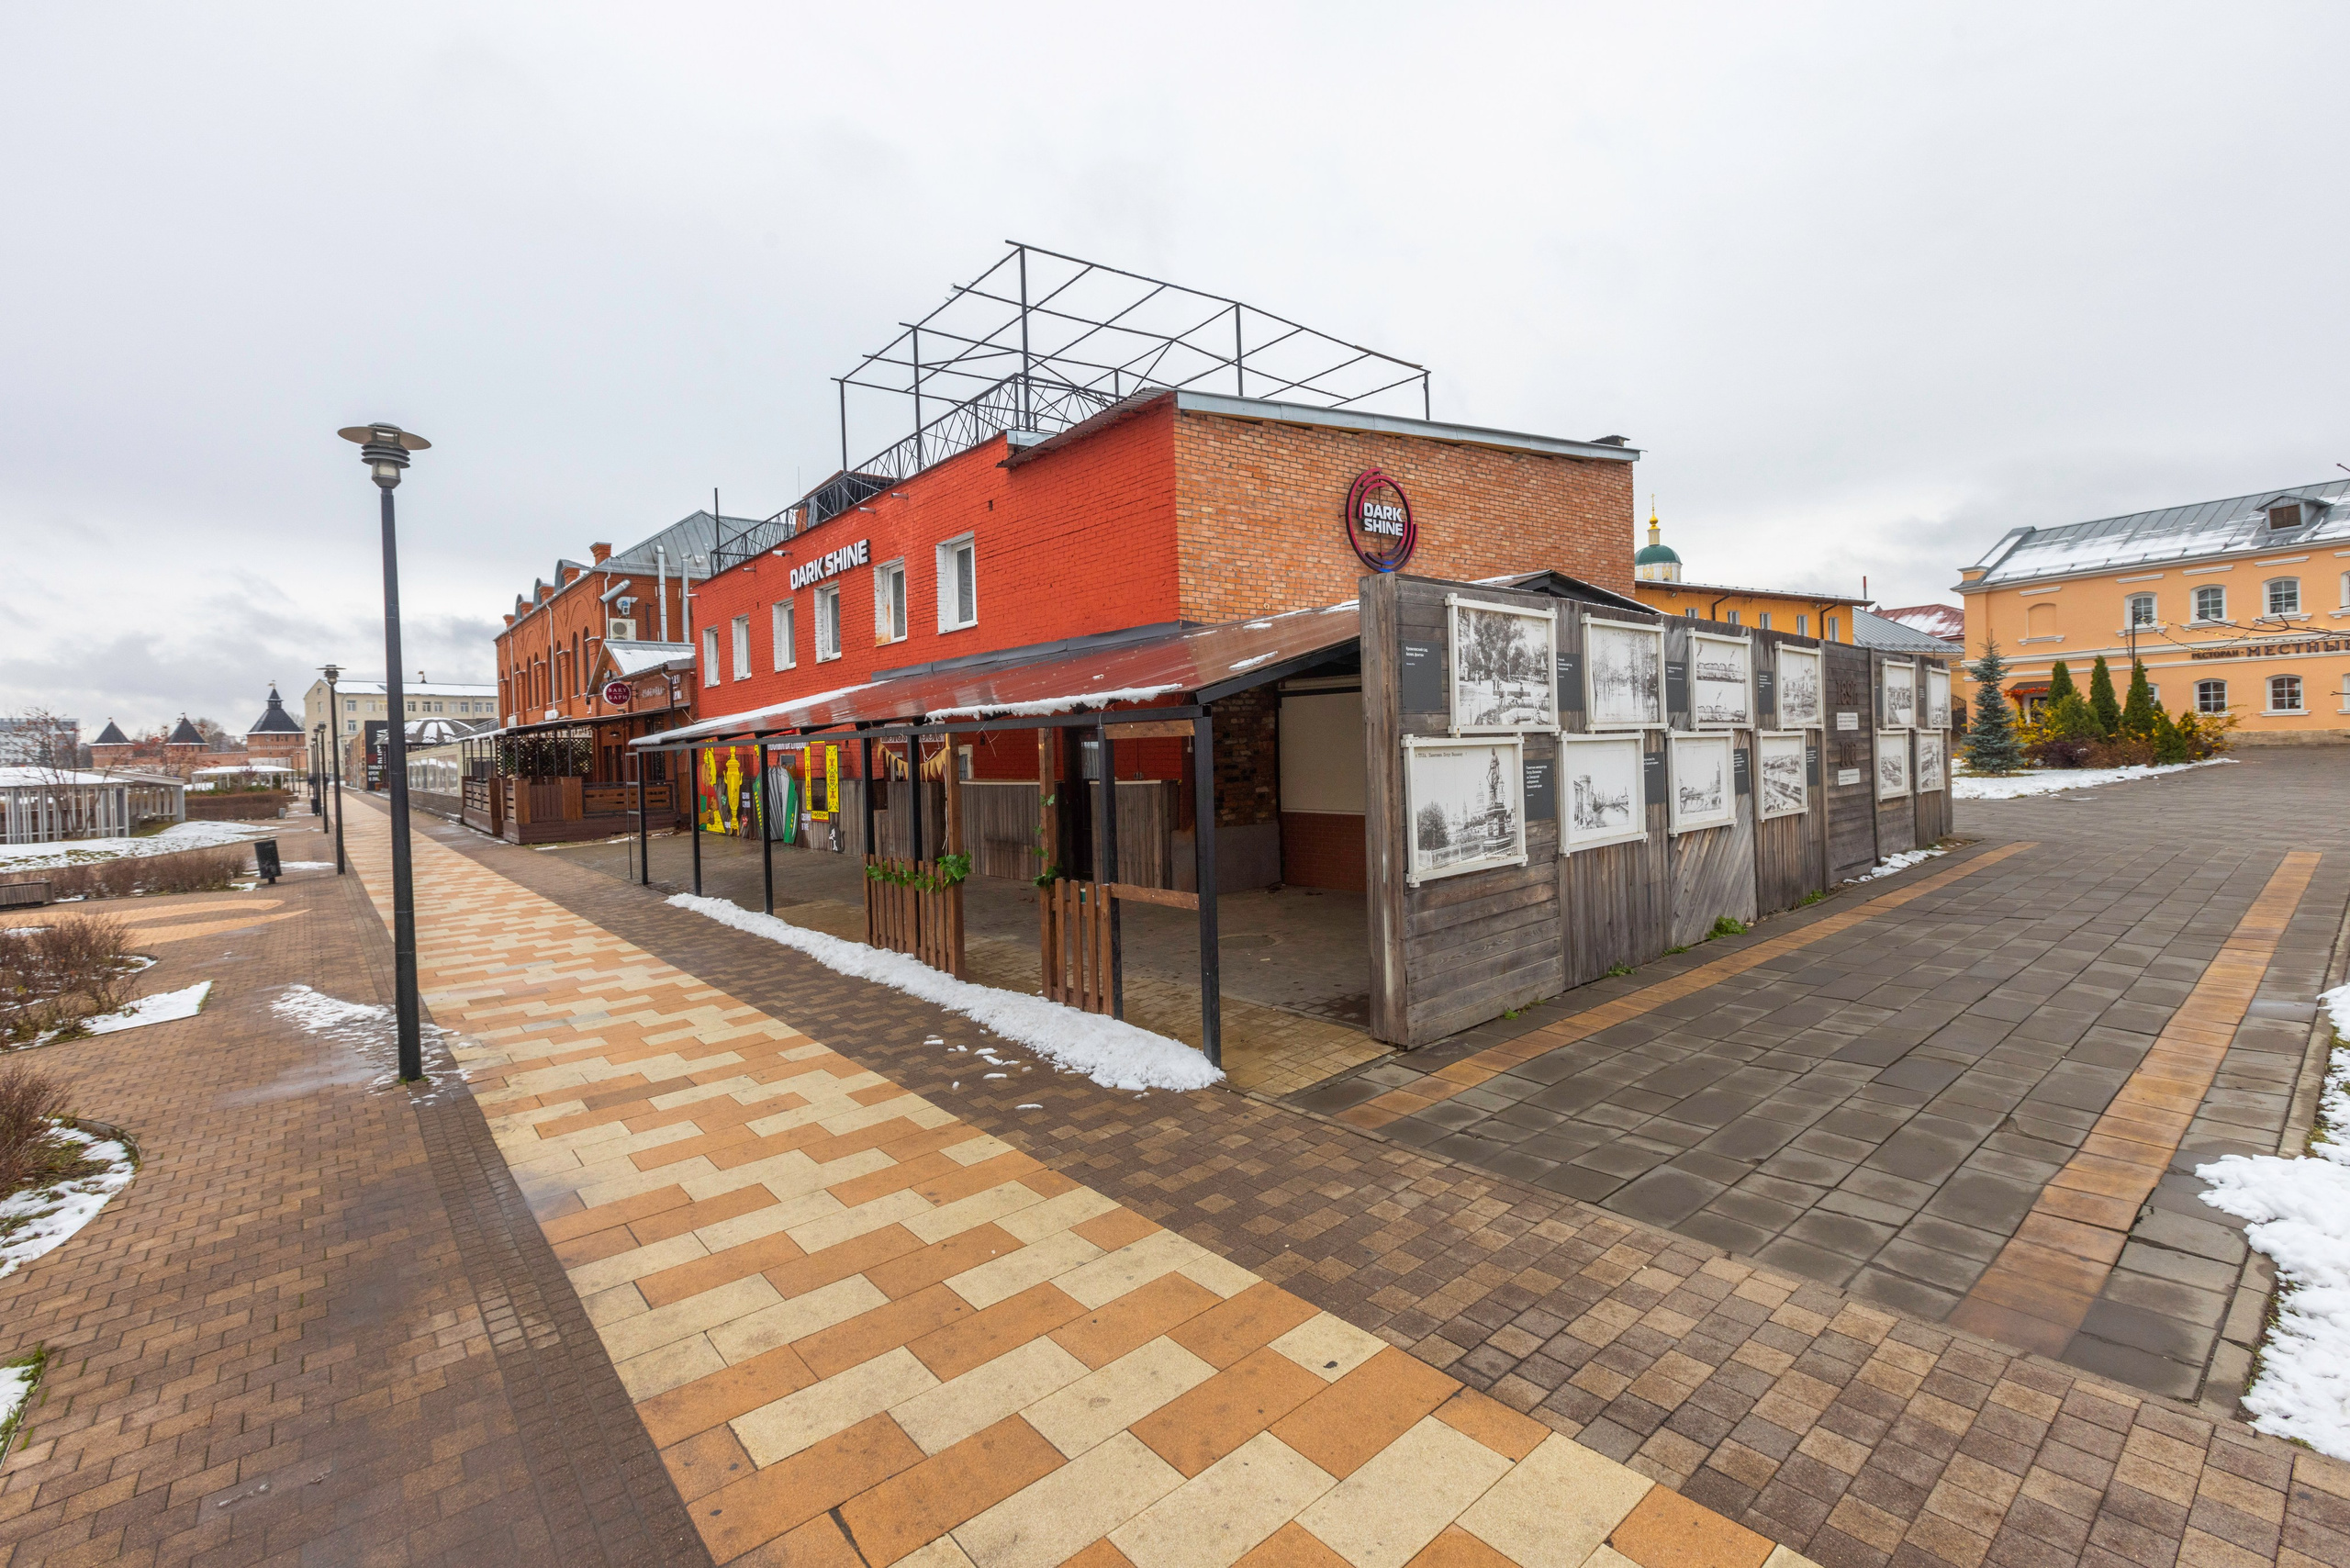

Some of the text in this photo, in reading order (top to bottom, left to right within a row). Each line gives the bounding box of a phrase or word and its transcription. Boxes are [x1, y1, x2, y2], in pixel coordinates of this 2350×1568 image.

[1363, 502, 1403, 521] DARK
[1363, 518, 1404, 536] SHINE
[789, 539, 868, 590] DARK SHINE
[2191, 649, 2239, 660] РЕСТОРАН
